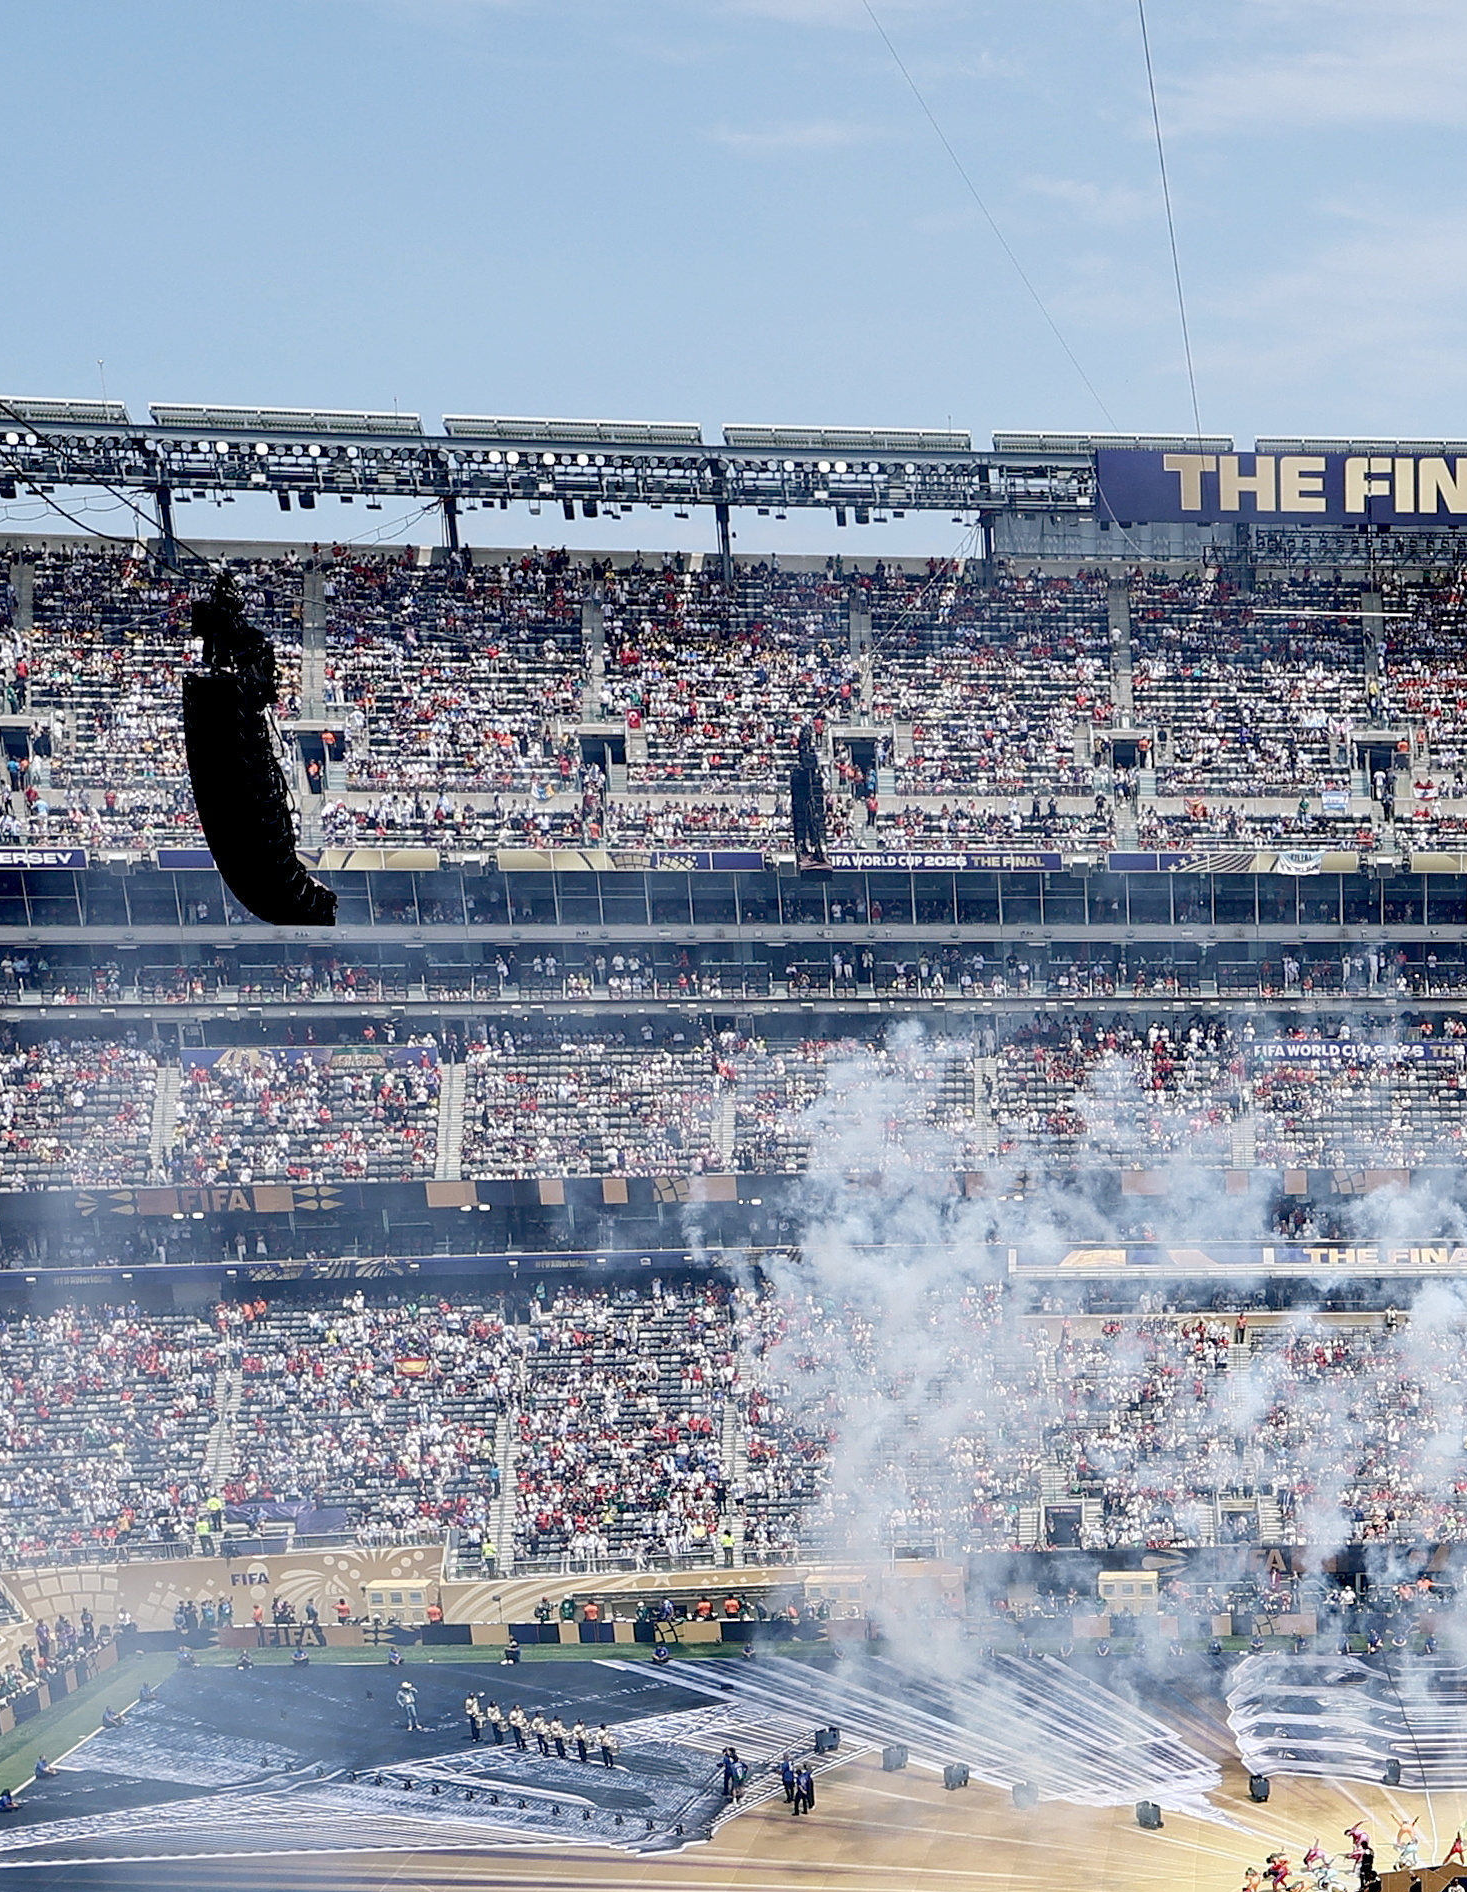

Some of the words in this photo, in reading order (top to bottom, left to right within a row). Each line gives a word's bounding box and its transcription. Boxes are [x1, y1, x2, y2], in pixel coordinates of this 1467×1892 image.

[1163, 455, 1327, 513] THE
[830, 855, 851, 867] IFA
[854, 855, 896, 867] WORLD
[899, 855, 922, 867] CUP
[924, 855, 966, 867] 2026
[971, 856, 999, 867] THE
[1002, 856, 1044, 867] FINAL
[1254, 1045, 1285, 1057] FIFA
[1288, 1045, 1341, 1058] WORLD
[182, 1189, 250, 1212] FIFA
[1305, 1248, 1379, 1263] THE
[231, 1574, 269, 1586] FIFA
[264, 1627, 318, 1646] FIFA
